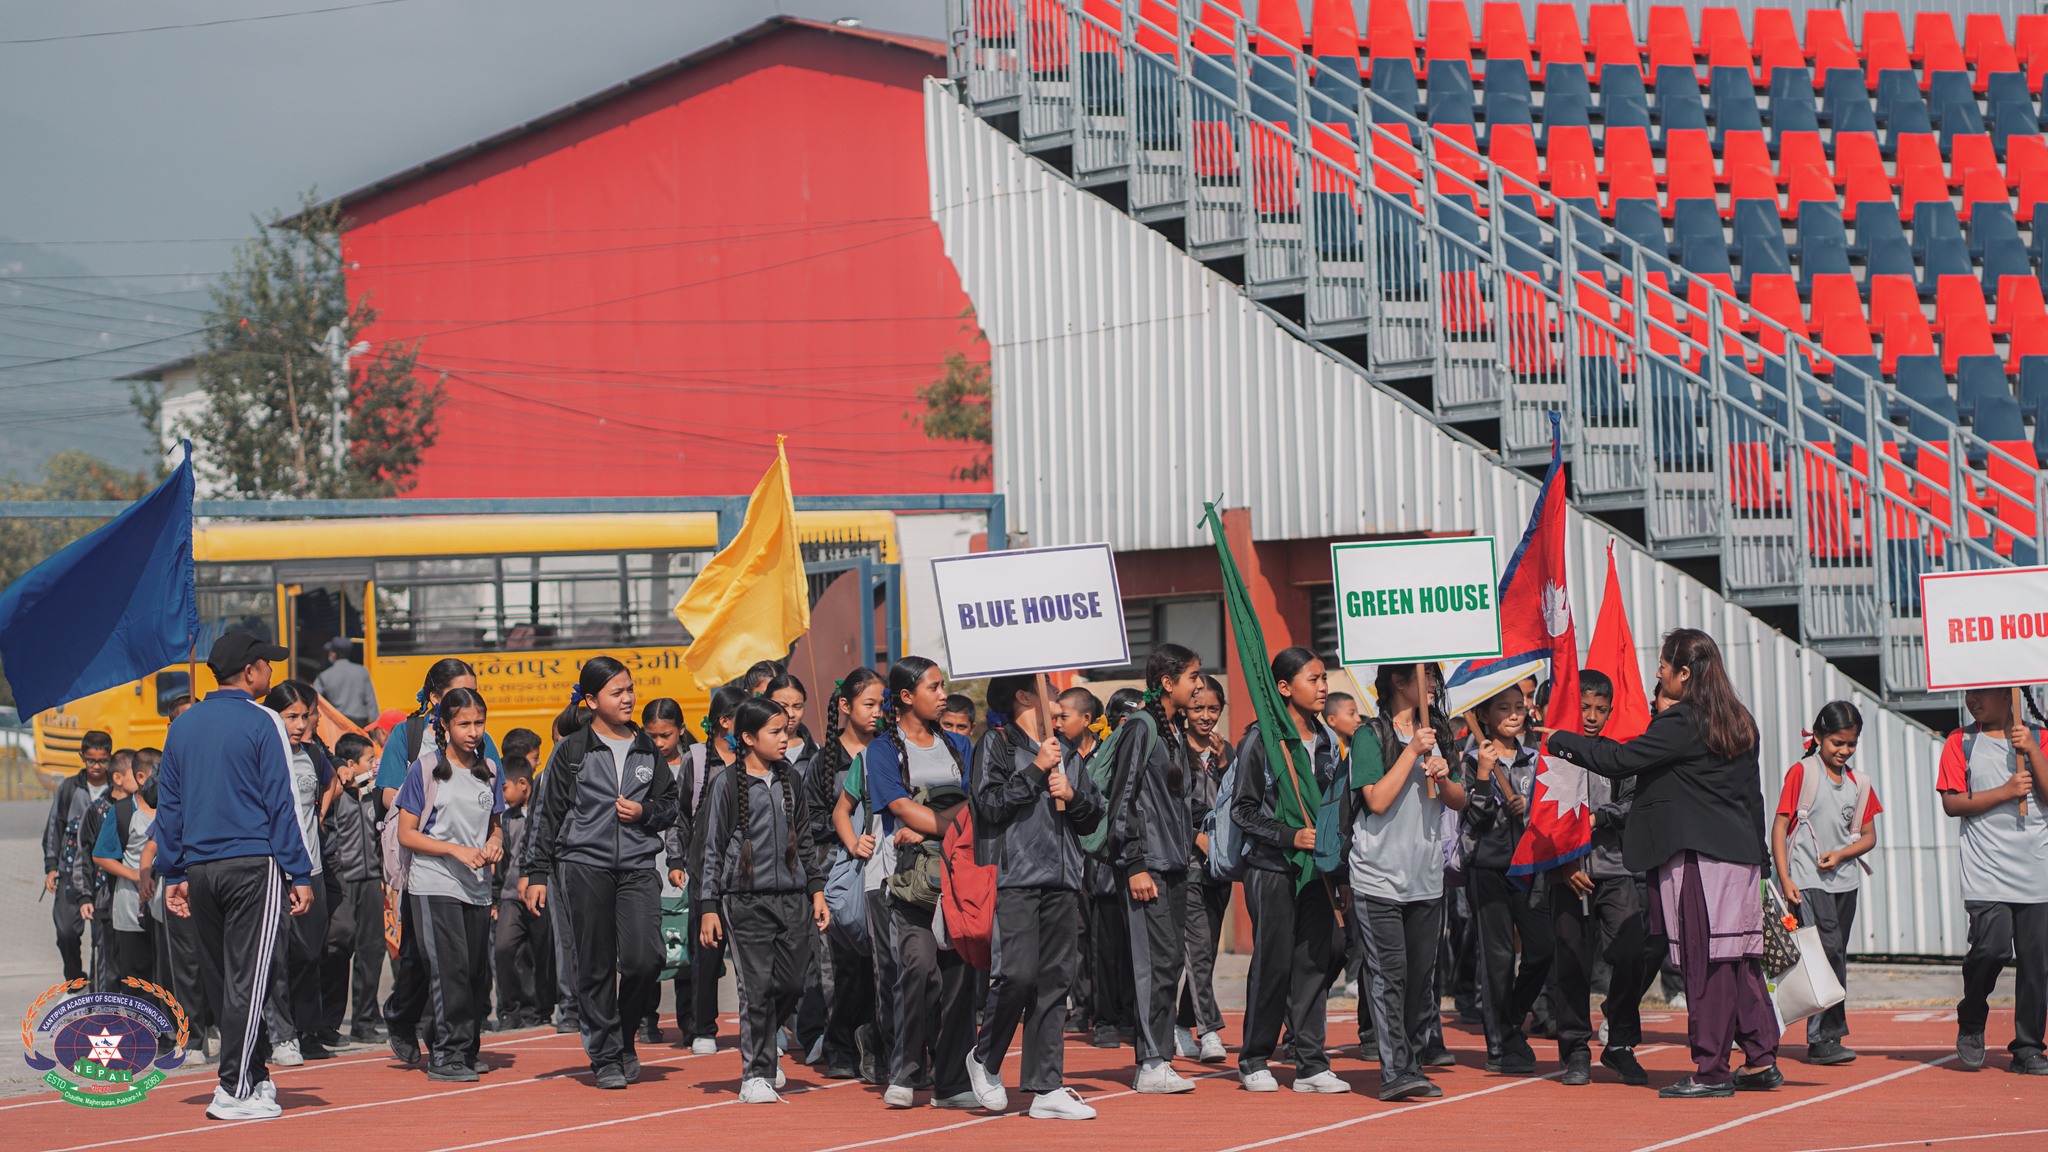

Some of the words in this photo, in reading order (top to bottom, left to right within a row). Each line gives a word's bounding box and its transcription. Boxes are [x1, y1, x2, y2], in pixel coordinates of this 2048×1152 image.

[957, 598, 1018, 631] BLUE
[1021, 591, 1102, 624] HOUSE
[1346, 587, 1414, 618] GREEN
[1420, 583, 1490, 614] HOUSE
[1948, 616, 1994, 644] RED
